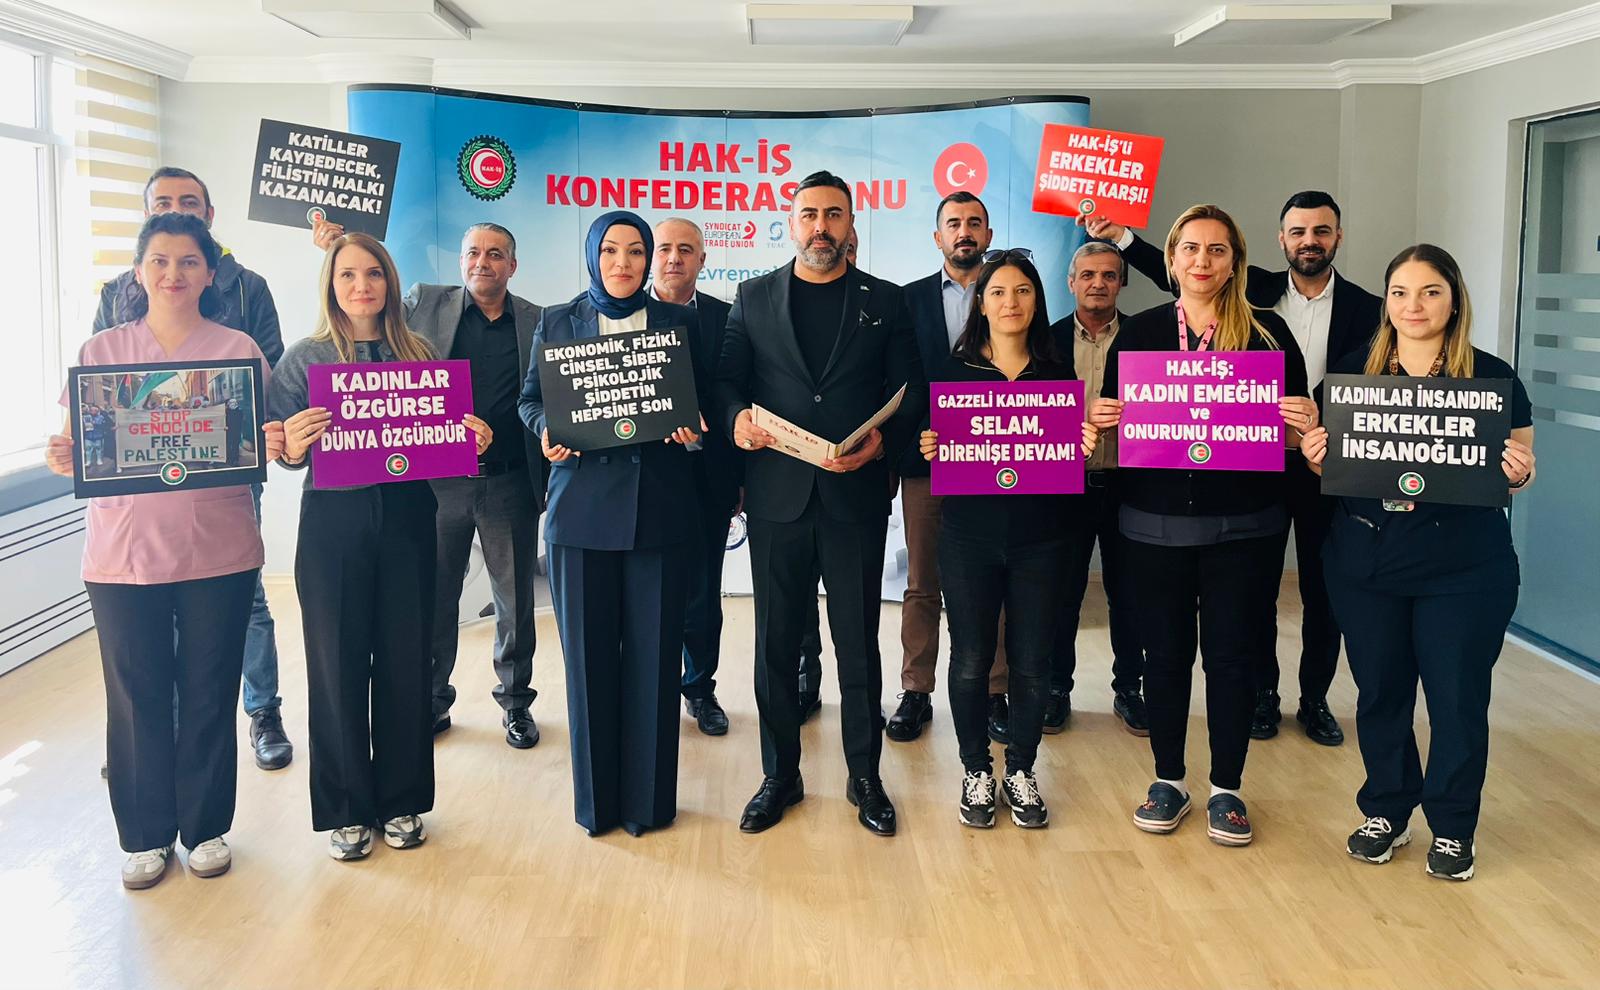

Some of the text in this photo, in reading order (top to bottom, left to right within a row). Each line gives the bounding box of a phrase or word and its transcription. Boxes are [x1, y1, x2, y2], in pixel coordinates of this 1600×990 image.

[288, 132, 368, 158] KATİLLER
[660, 139, 793, 176] HAK-İŞ
[1068, 133, 1133, 156] HAK-İŞ'li
[269, 147, 381, 179] KAYBEDECEK,
[1049, 151, 1144, 180] ERKEKLER
[261, 162, 385, 197] FİLİSTİN HALKI
[1039, 170, 1149, 205] ŞİDDETE KARŞI!
[259, 180, 382, 215] KAZANACAK!
[546, 174, 907, 212] KONFEDERASNU
[704, 222, 741, 231] SYNDICAT
[704, 239, 755, 248] TRADE UNION
[697, 262, 778, 281] Evrense
[544, 330, 681, 362] EKONOMİK, FİZİKİ,
[559, 350, 671, 376] CİNSEL, SİBER,
[1166, 355, 1234, 380] HAK-İŞ:
[331, 369, 450, 393] KADINLAR
[572, 365, 663, 391] PSİKOLOJİK
[584, 382, 656, 408] ŞİDDETİN
[938, 390, 1076, 408] GAZZELİ KADINLARA
[1123, 379, 1279, 404] KADIN EMEĞİNİ
[1330, 384, 1503, 413] KADINLAR İNSANDIR;
[150, 410, 191, 422] STOP
[340, 393, 446, 420] ÖZGÜRSE
[571, 398, 673, 424] HEPSİNE SON
[1189, 407, 1210, 420] ve
[128, 420, 214, 435] GENOCIDE
[320, 419, 467, 452] DÜNYA ÖZGÜRDÜR
[970, 415, 1044, 437] SELAM,
[1123, 423, 1279, 442] ONURUNU KORUR!
[1352, 411, 1476, 438] ERKEKLER
[124, 446, 219, 462] PALESTINE
[151, 434, 191, 448] FREE
[939, 439, 1076, 465] DİRENİŞE DEVAM!
[1342, 433, 1487, 467] İNSANOĞLU!
